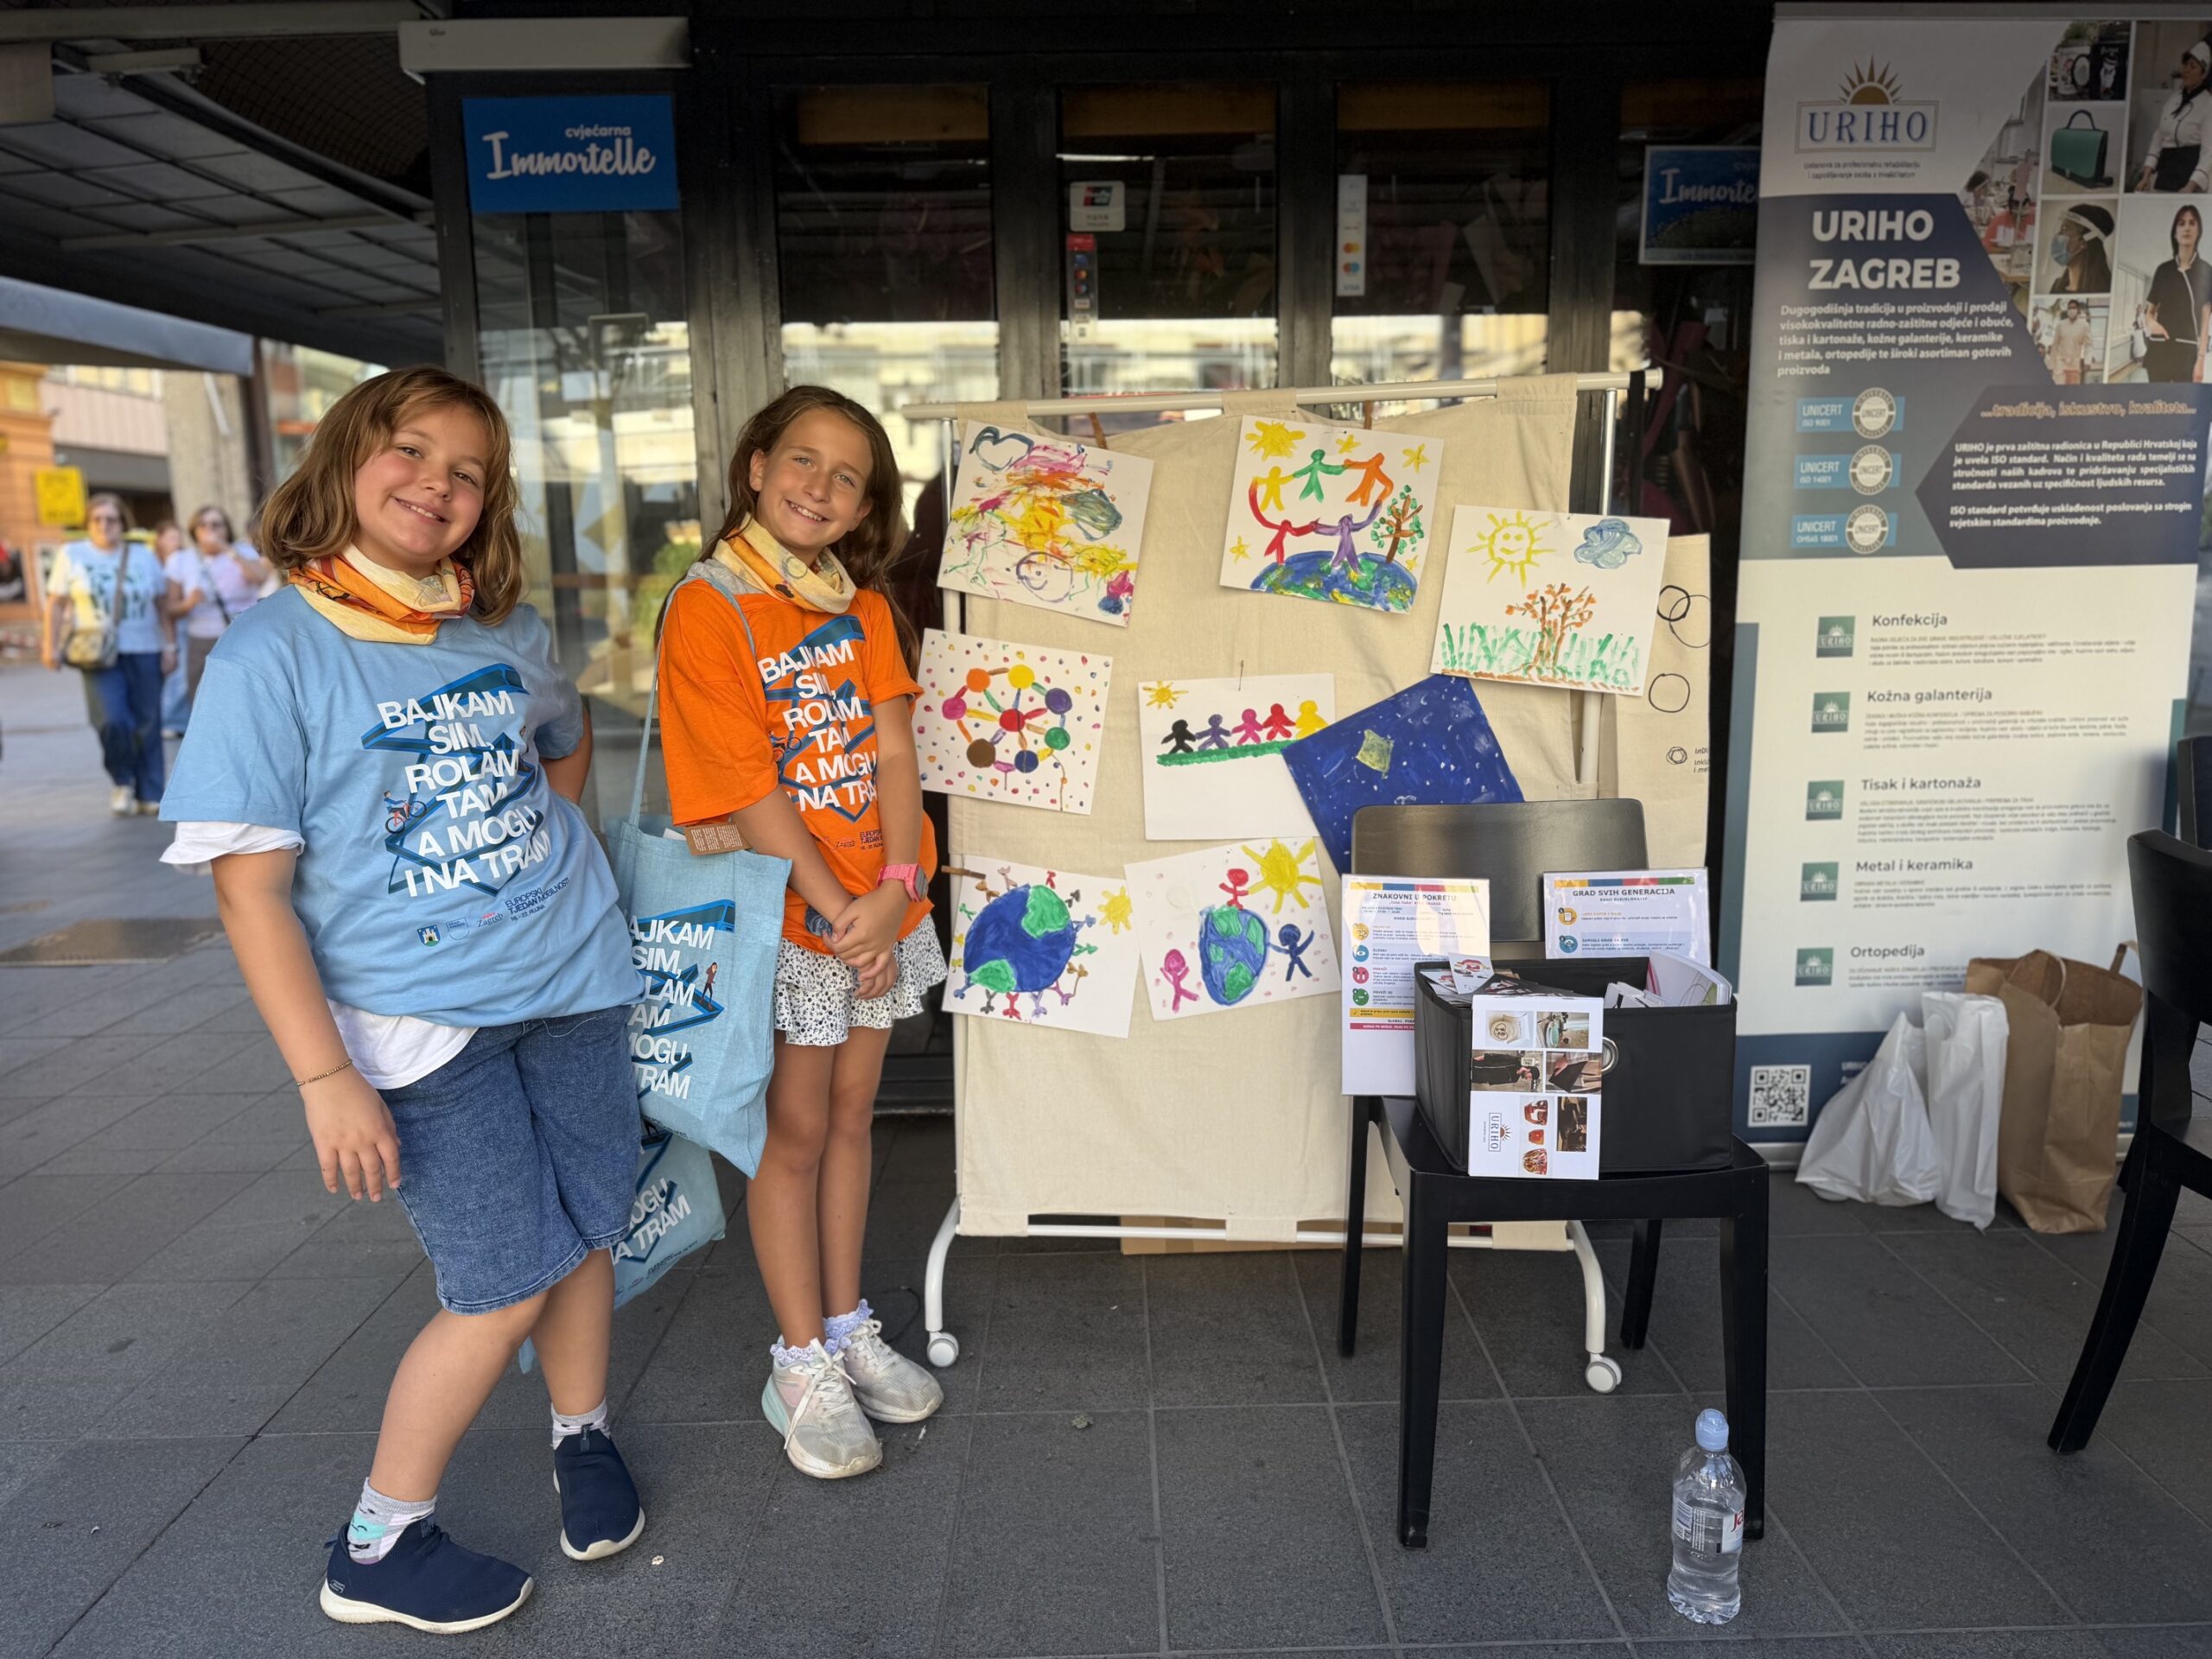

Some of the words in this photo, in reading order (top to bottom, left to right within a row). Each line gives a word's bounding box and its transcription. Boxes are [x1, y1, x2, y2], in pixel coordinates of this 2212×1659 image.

[565, 124, 631, 140] cvjećarna
[1808, 111, 1927, 143] URIHO
[482, 131, 656, 180] Immortelle
[1659, 168, 1759, 205] Immorte
[1812, 210, 1934, 241] URIHO
[1808, 258, 1961, 290] ZAGREB
[1781, 303, 1853, 317] Dugogodišnja
[1855, 302, 1895, 315] tradicija
[1906, 302, 1962, 315] proizvodnji
[1970, 302, 2007, 315] prodaji
[1780, 319, 1865, 330] visokokvalitetne
[1866, 318, 1937, 329] radno-zaštitne
[1939, 317, 1973, 329] odjeće
[1980, 316, 2014, 328] obuće,
[1779, 335, 1804, 346] tiska
[1813, 334, 1865, 346] kartonaže,
[1867, 334, 1896, 344] kožne
[1898, 333, 1954, 346] galanterije,
[1955, 332, 2003, 343] keramike
[1783, 350, 1823, 361] metala,
[1825, 349, 1877, 361] ortopedije
[1878, 350, 1889, 359] te
[1891, 347, 1918, 359] široki
[1919, 348, 1969, 359] asortiman
[1971, 346, 2012, 360] gotovih
[1777, 365, 1830, 378] proizvoda
[1802, 404, 1843, 416] UNICERT
[2058, 401, 2126, 417] iskustvo,
[1955, 443, 1985, 453] URIHO
[1986, 442, 1994, 453] je
[1995, 444, 2016, 454] prva
[2018, 442, 2050, 452] zaštitna
[2051, 441, 2092, 450] radionica
[2101, 440, 2142, 451] Republici
[2144, 439, 2181, 450] Hrvatskoj
[2183, 439, 2197, 450] koja
[1801, 461, 1840, 474] UNICERT
[1953, 455, 1962, 467] je
[1965, 455, 1989, 465] uvela
[1991, 455, 2007, 464] ISO
[2008, 454, 2049, 464] standard.
[2053, 454, 2078, 463] Način
[2086, 453, 2125, 462] kvaliteta
[2127, 453, 2146, 461] rada
[2148, 452, 2176, 463] temelji
[1953, 467, 1998, 478] stručnosti
[2000, 467, 2024, 476] naših
[2028, 467, 2062, 476] kadrova
[2079, 466, 2136, 477] pridržavanju
[2140, 464, 2196, 476] specijalističkih
[1952, 480, 1997, 490] standarda
[1999, 480, 2031, 489] vezanih
[2096, 478, 2132, 489] ljudskih
[1950, 505, 1966, 515] ISO
[1967, 505, 2007, 514] standard
[2106, 501, 2152, 514] poslovanja
[2164, 501, 2192, 513] strogim
[1797, 521, 1836, 532] UNICERT
[1949, 518, 1991, 529] svjetskim
[1993, 517, 2046, 526] standardima
[2047, 515, 2101, 527] proizvodnje.
[1872, 613, 1948, 628] Konfekcija
[1867, 690, 1910, 702] Kožna
[1915, 688, 1993, 704] galanterija
[377, 690, 516, 729] BAJKAM
[782, 696, 863, 731] ROLAM
[428, 723, 494, 755] SIM,
[405, 750, 520, 793] ROLAM
[795, 762, 817, 784] A
[1861, 779, 1897, 791] Tisak
[1902, 779, 1906, 790] i
[1910, 777, 1981, 790] kartonaža
[436, 782, 508, 819] TAM
[798, 785, 841, 812] NA
[842, 779, 877, 805] TRA
[418, 831, 446, 857] A
[448, 804, 538, 854] MOGU
[860, 830, 882, 838] EUROPS
[404, 869, 418, 897] I
[422, 859, 480, 893] NA
[480, 831, 552, 878] TRAM
[1856, 859, 1895, 872] Metal
[1899, 859, 1903, 871] i
[1907, 857, 1974, 871] keramika
[505, 887, 543, 908] EUROPSKI
[508, 898, 537, 914] TJEDAN
[537, 877, 569, 902] MOBILNOSTI
[628, 915, 715, 950] AJKAM
[1850, 944, 1925, 959] Ortopedija
[632, 945, 683, 978] SIM,
[645, 976, 696, 1007] LAM
[627, 1004, 671, 1029] AM
[1491, 1116, 1499, 1149] URIHO
[633, 1195, 691, 1250] TRAM
